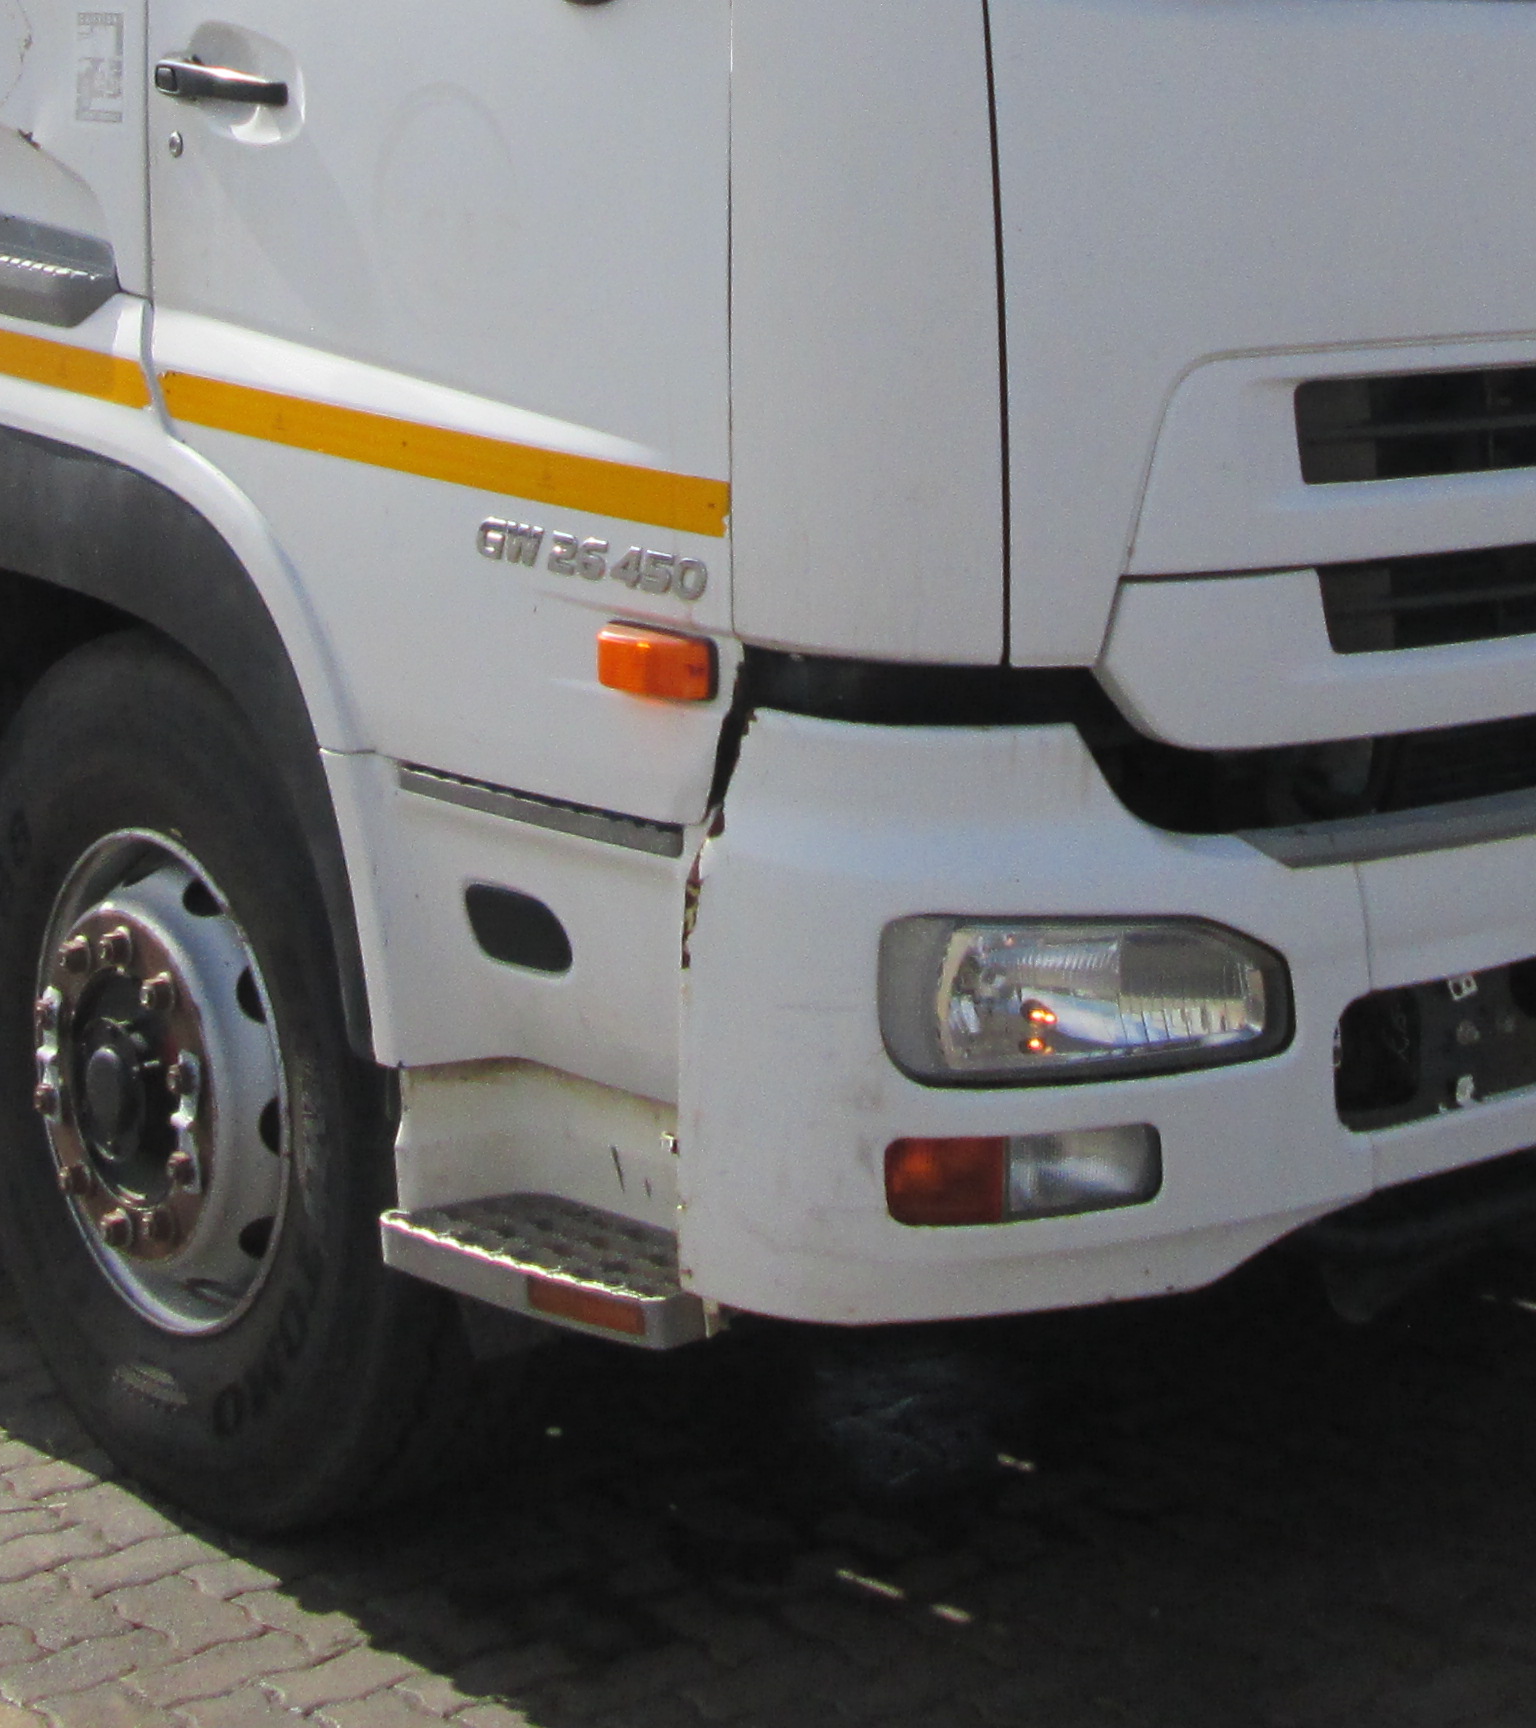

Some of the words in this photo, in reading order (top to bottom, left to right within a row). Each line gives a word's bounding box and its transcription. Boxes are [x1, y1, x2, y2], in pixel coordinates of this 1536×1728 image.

[476, 516, 545, 568] GW
[547, 530, 610, 581] 26
[610, 545, 708, 601] 450
